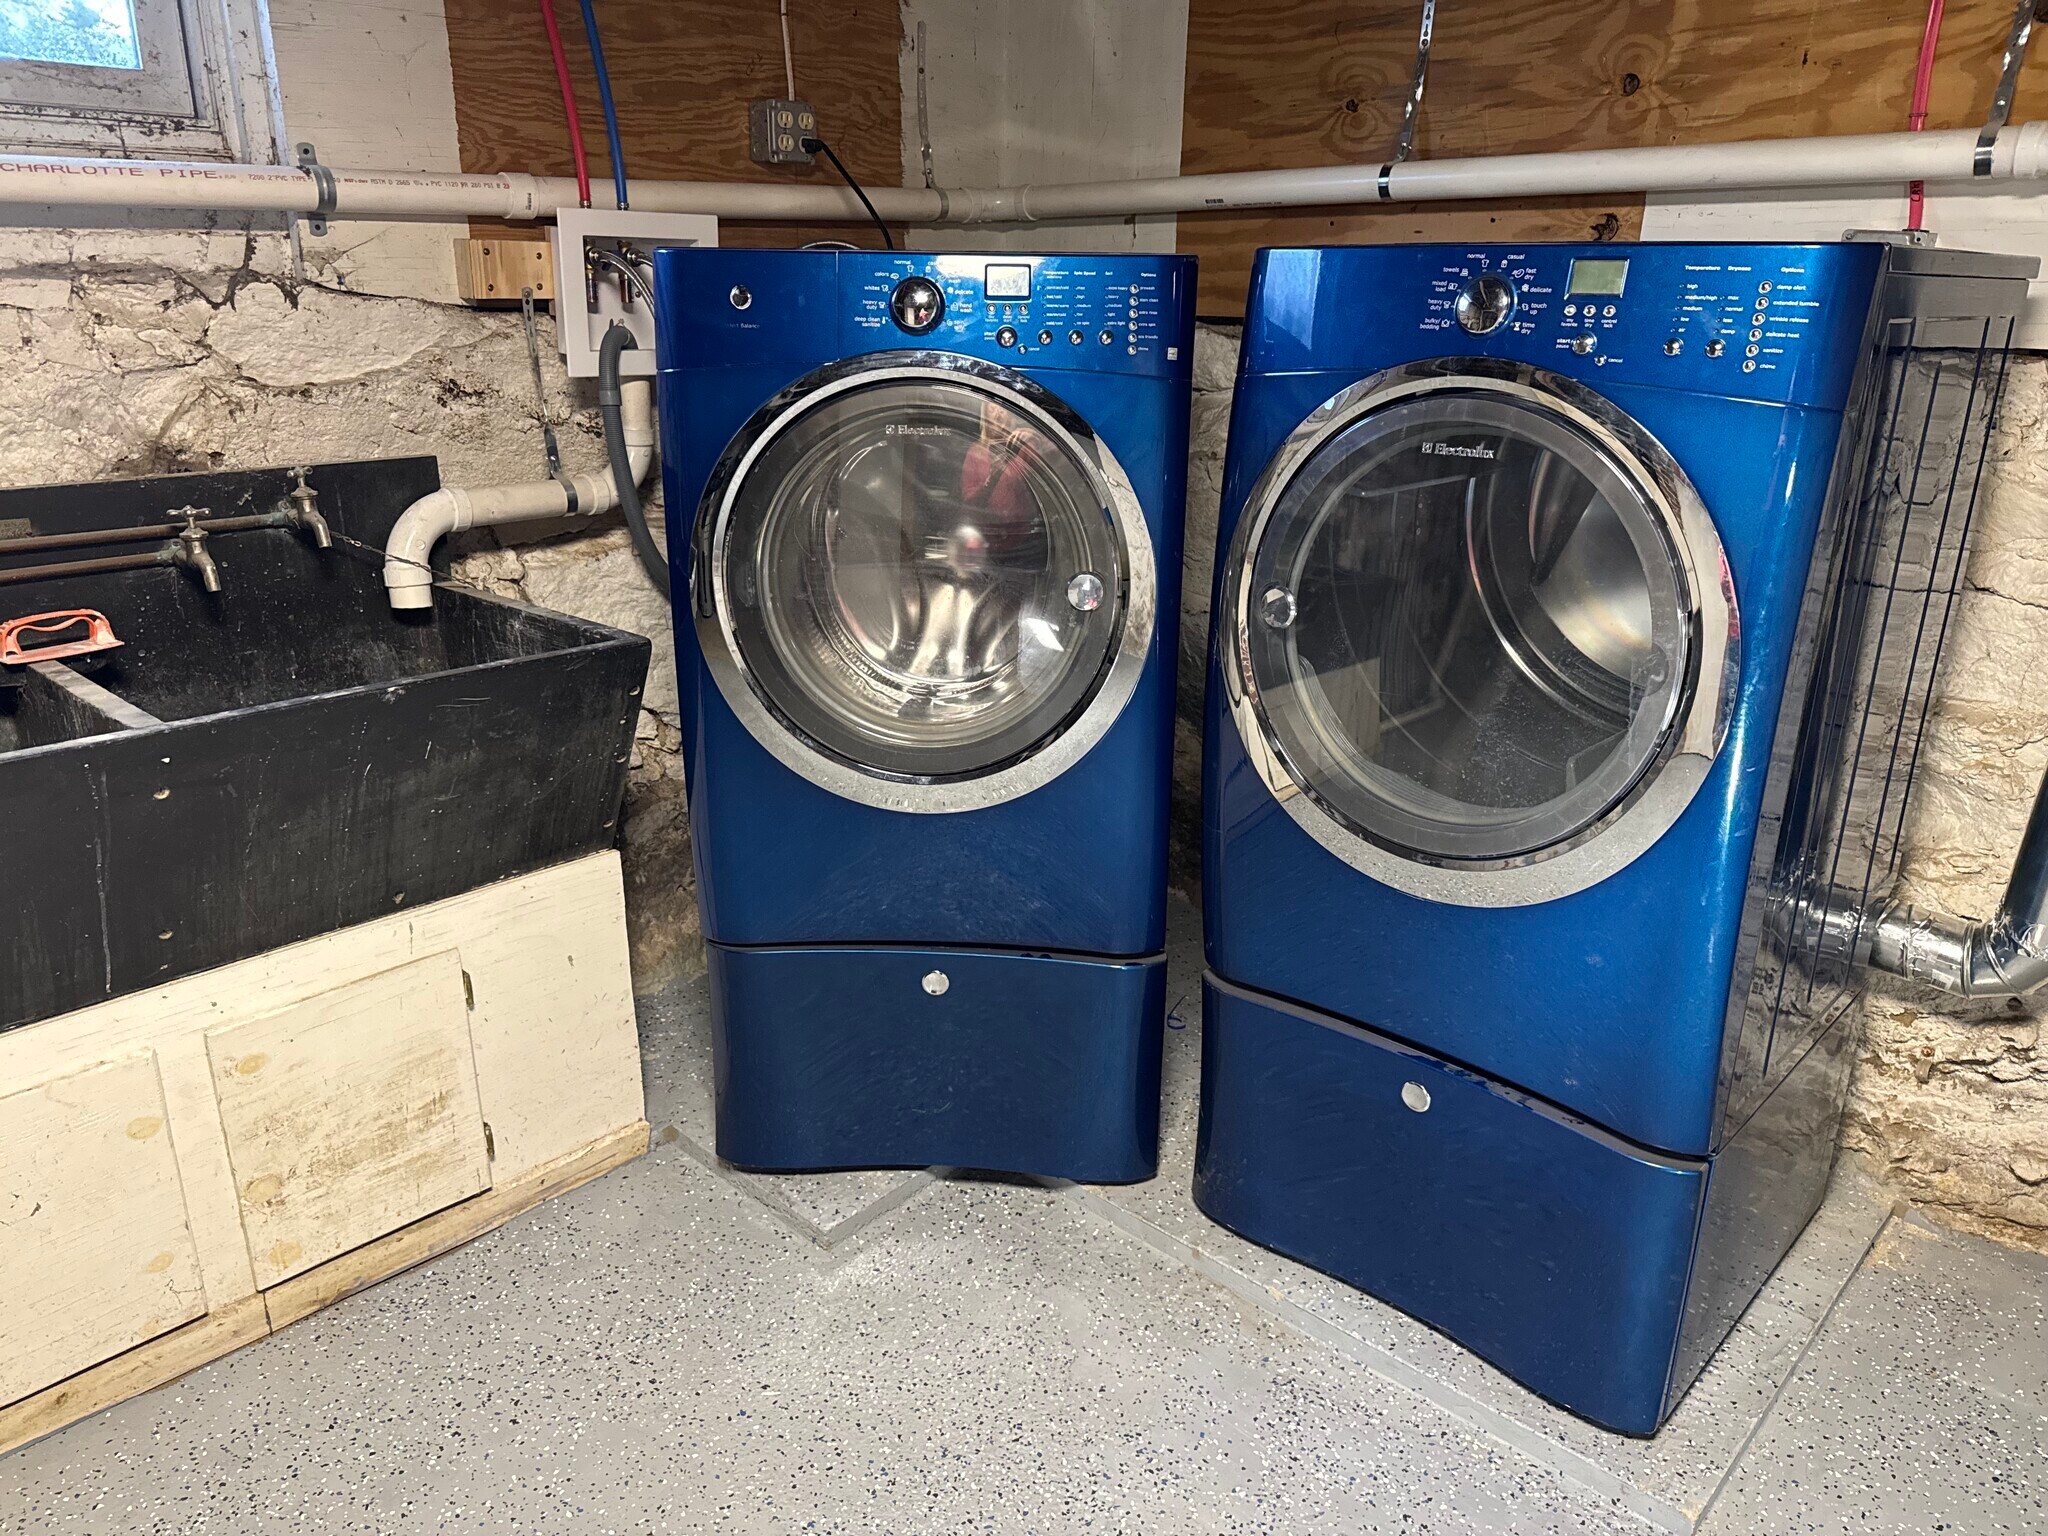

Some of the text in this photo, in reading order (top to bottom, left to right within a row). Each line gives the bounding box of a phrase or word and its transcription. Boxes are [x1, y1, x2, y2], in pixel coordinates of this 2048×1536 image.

[0, 163, 144, 176] CHARLOTTE
[898, 425, 952, 436] Electrolux
[1434, 442, 1494, 459] Electrolux
